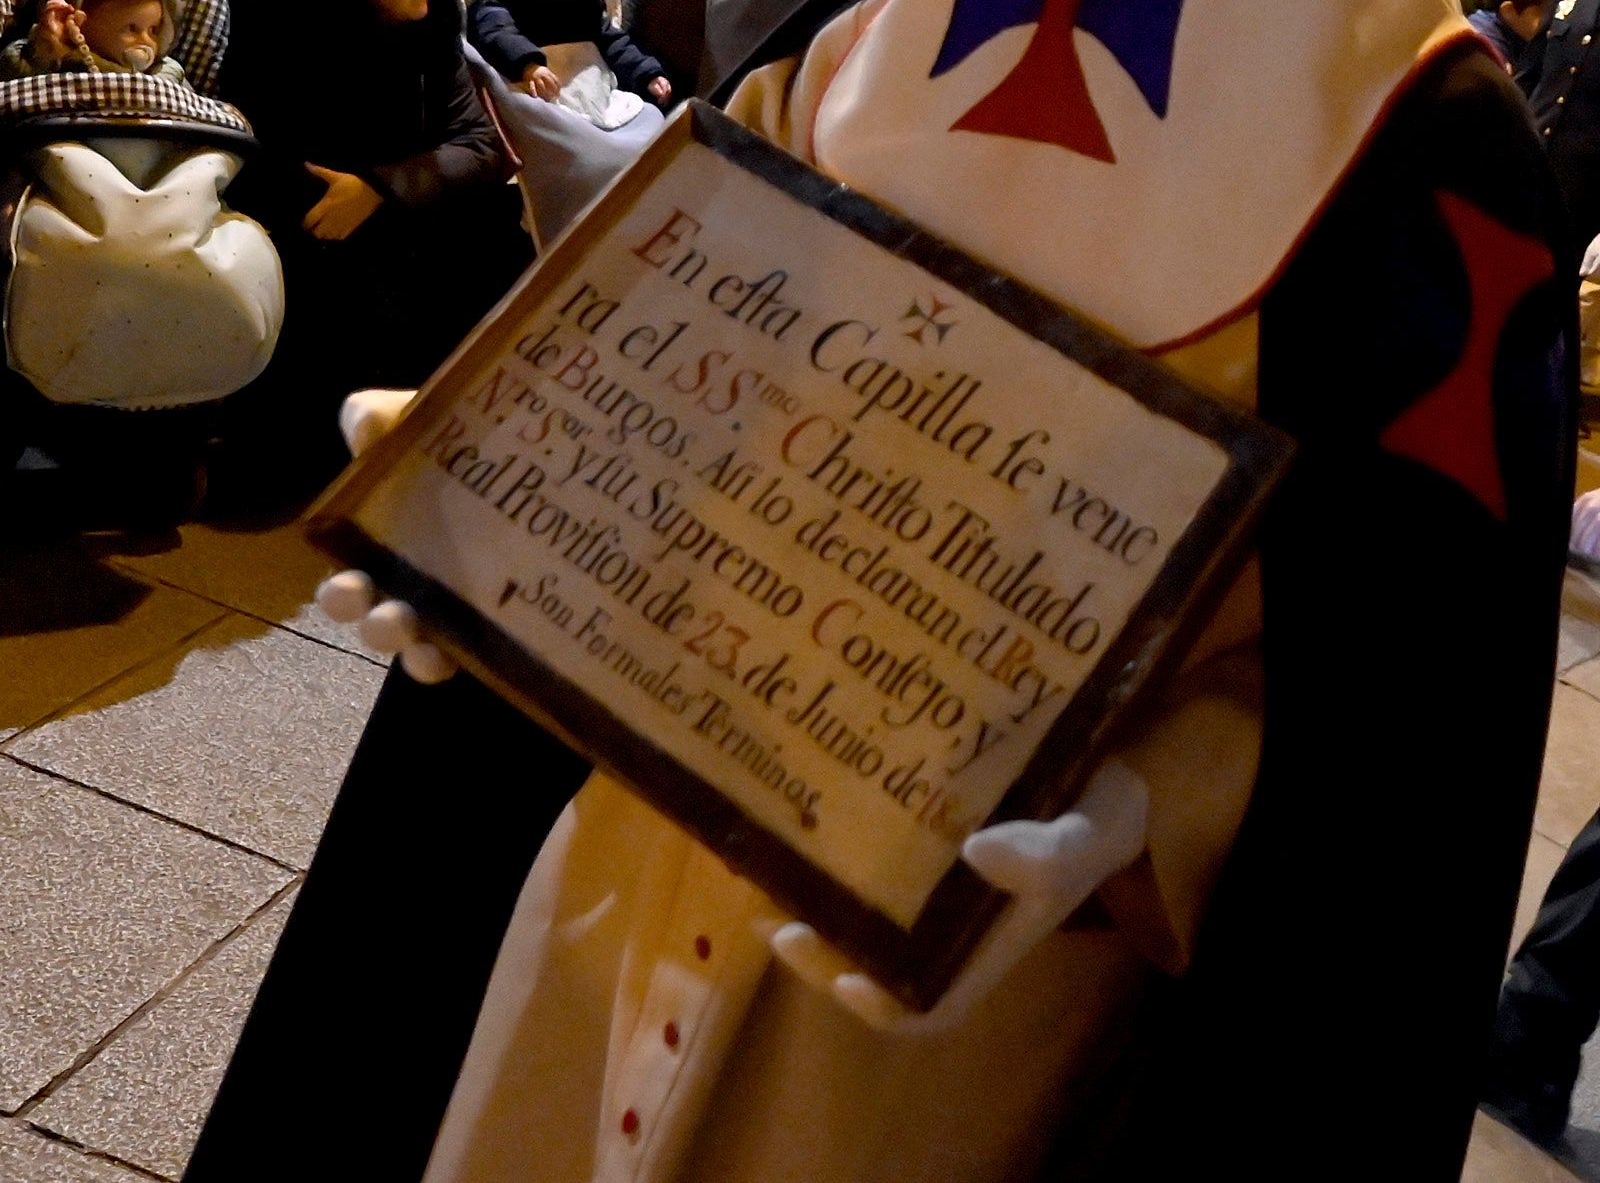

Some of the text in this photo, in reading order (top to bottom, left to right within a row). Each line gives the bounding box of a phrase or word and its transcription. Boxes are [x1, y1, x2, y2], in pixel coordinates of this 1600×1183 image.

[558, 283, 621, 335] ra
[618, 321, 691, 371] el
[929, 500, 1101, 655] Titulado
[630, 209, 708, 288] En
[810, 319, 993, 462] Capilla
[423, 417, 518, 498] Real
[642, 579, 695, 634] de
[742, 653, 798, 706] de
[786, 679, 885, 778] Junio
[882, 757, 930, 809] de
[515, 324, 561, 368] de
[749, 477, 794, 526] lo
[795, 509, 961, 646] declaran
[627, 478, 804, 617] Supremo
[573, 605, 694, 716] Formales
